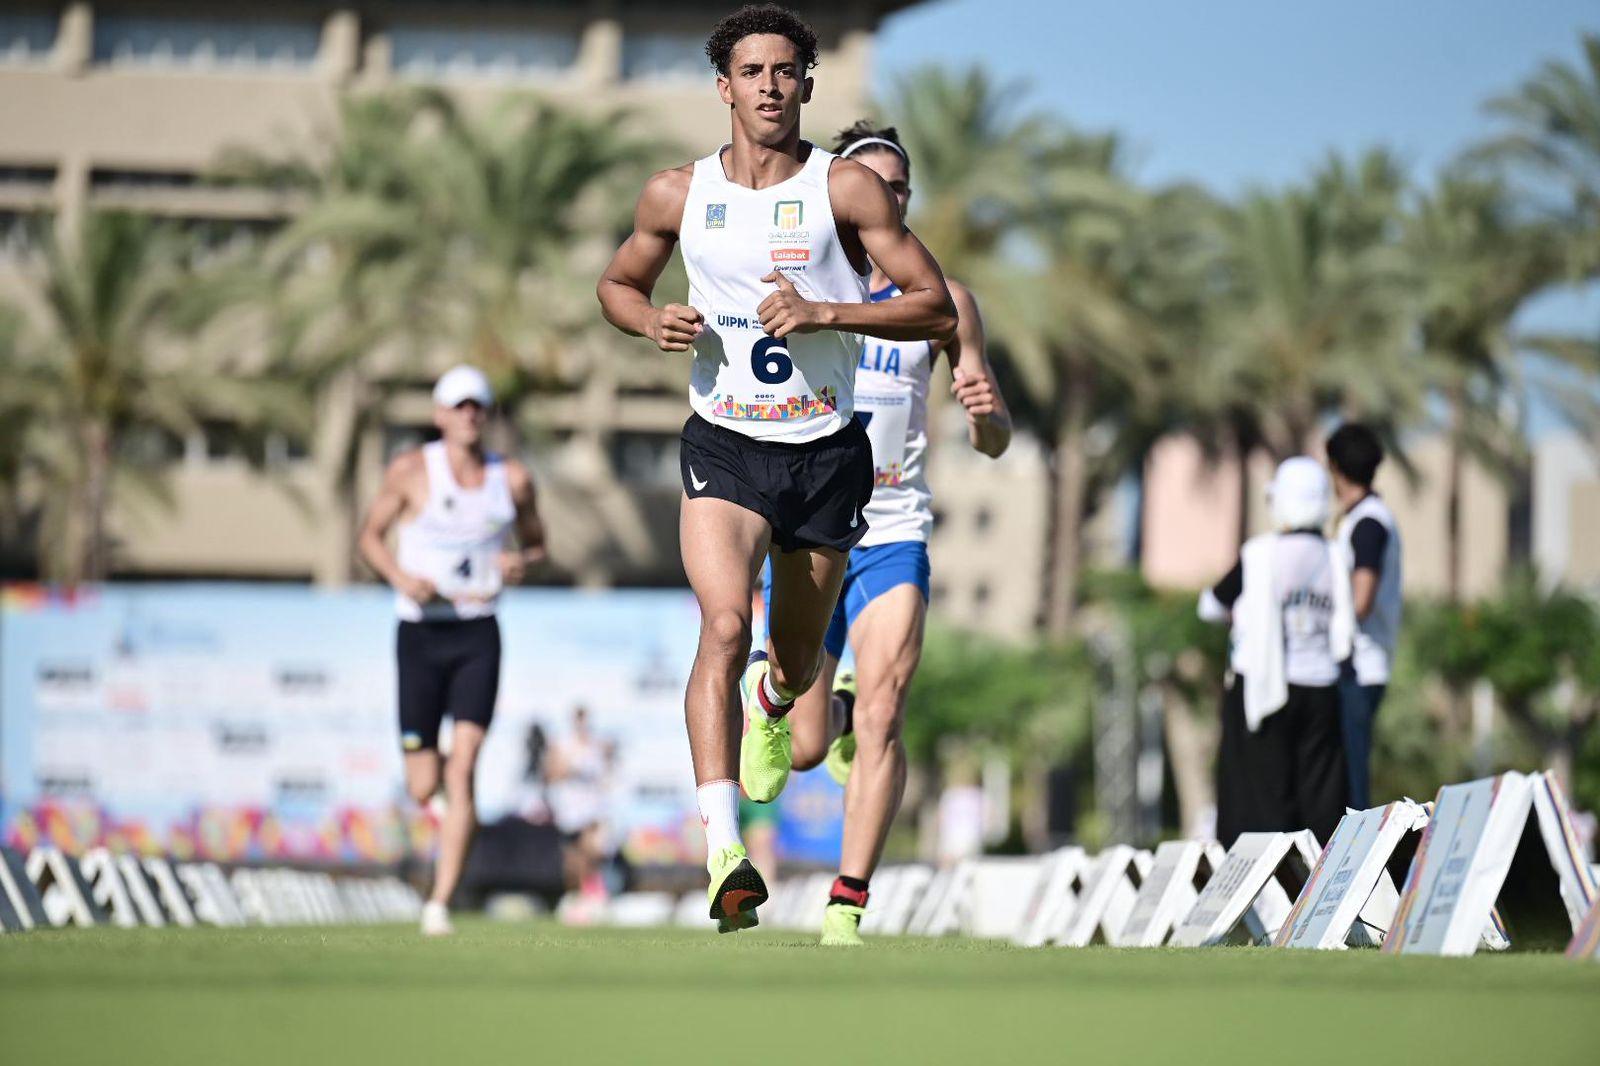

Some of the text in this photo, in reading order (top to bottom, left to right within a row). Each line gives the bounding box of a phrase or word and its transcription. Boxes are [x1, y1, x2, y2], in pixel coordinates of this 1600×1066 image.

[707, 219, 725, 227] UIPM
[717, 314, 748, 329] UIPM
[750, 336, 792, 383] 6
[859, 343, 901, 376] LIA
